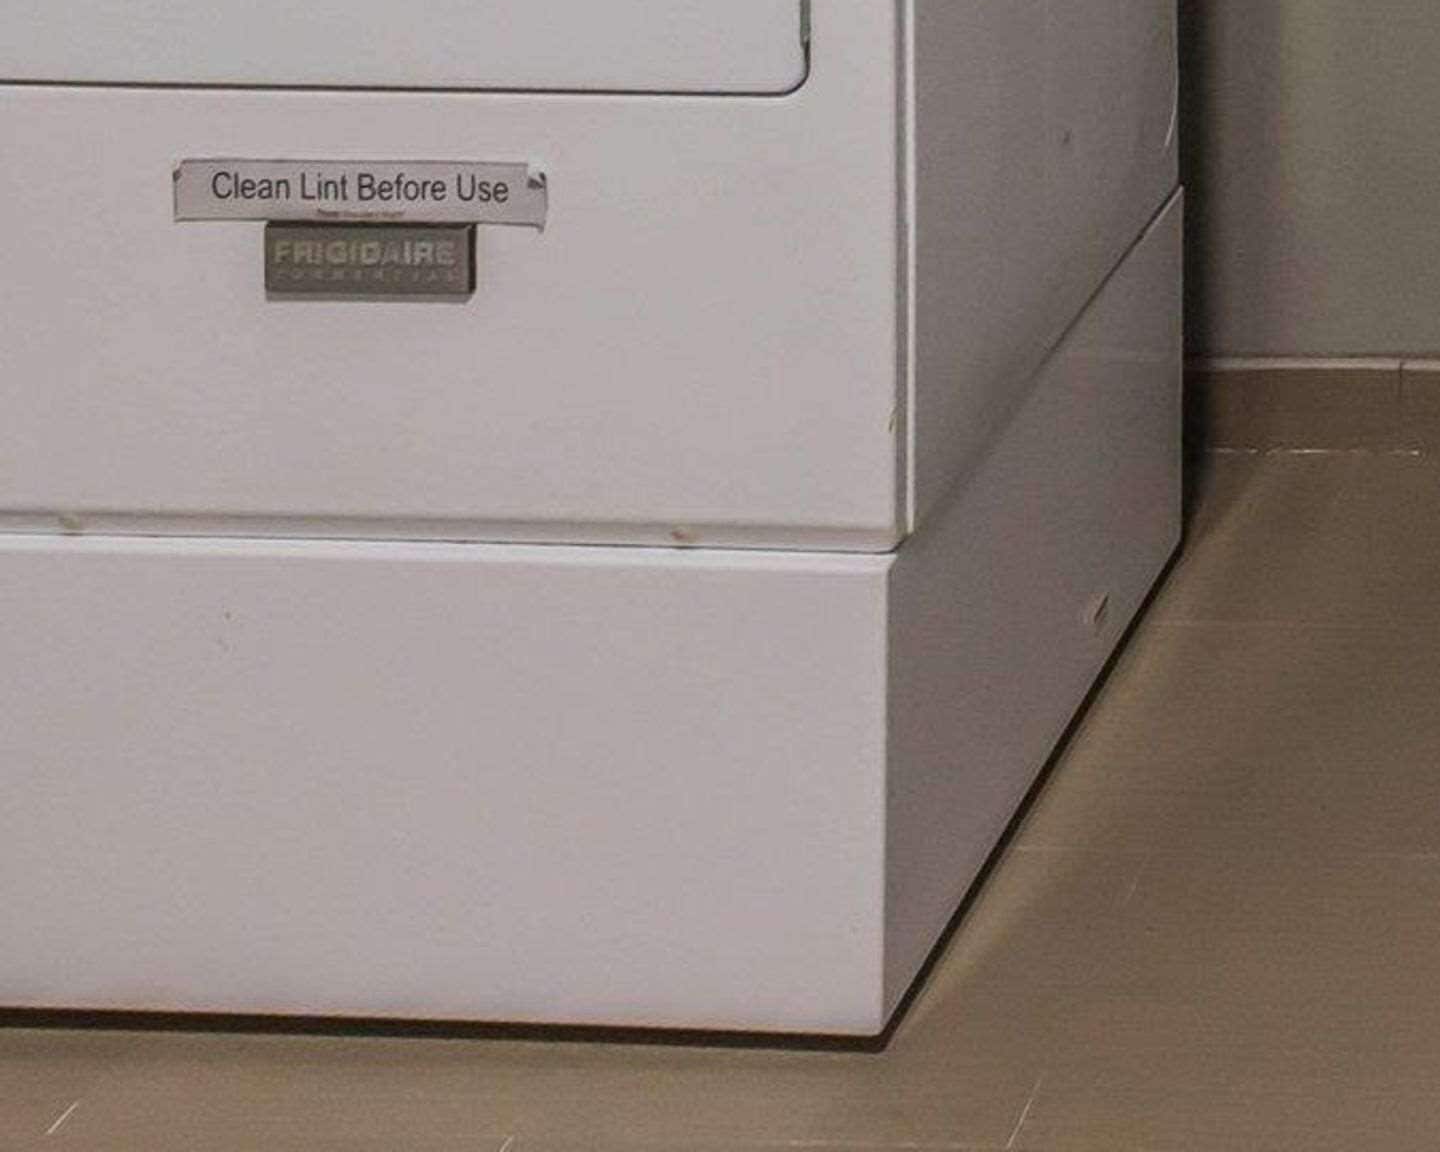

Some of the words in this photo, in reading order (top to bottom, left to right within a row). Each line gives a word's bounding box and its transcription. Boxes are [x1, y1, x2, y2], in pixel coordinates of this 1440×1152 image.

[211, 171, 291, 200] Clean
[300, 172, 348, 201] Lint
[357, 173, 447, 202] Before
[456, 174, 510, 203] Use
[274, 239, 456, 265] FRIGIDAIRE
